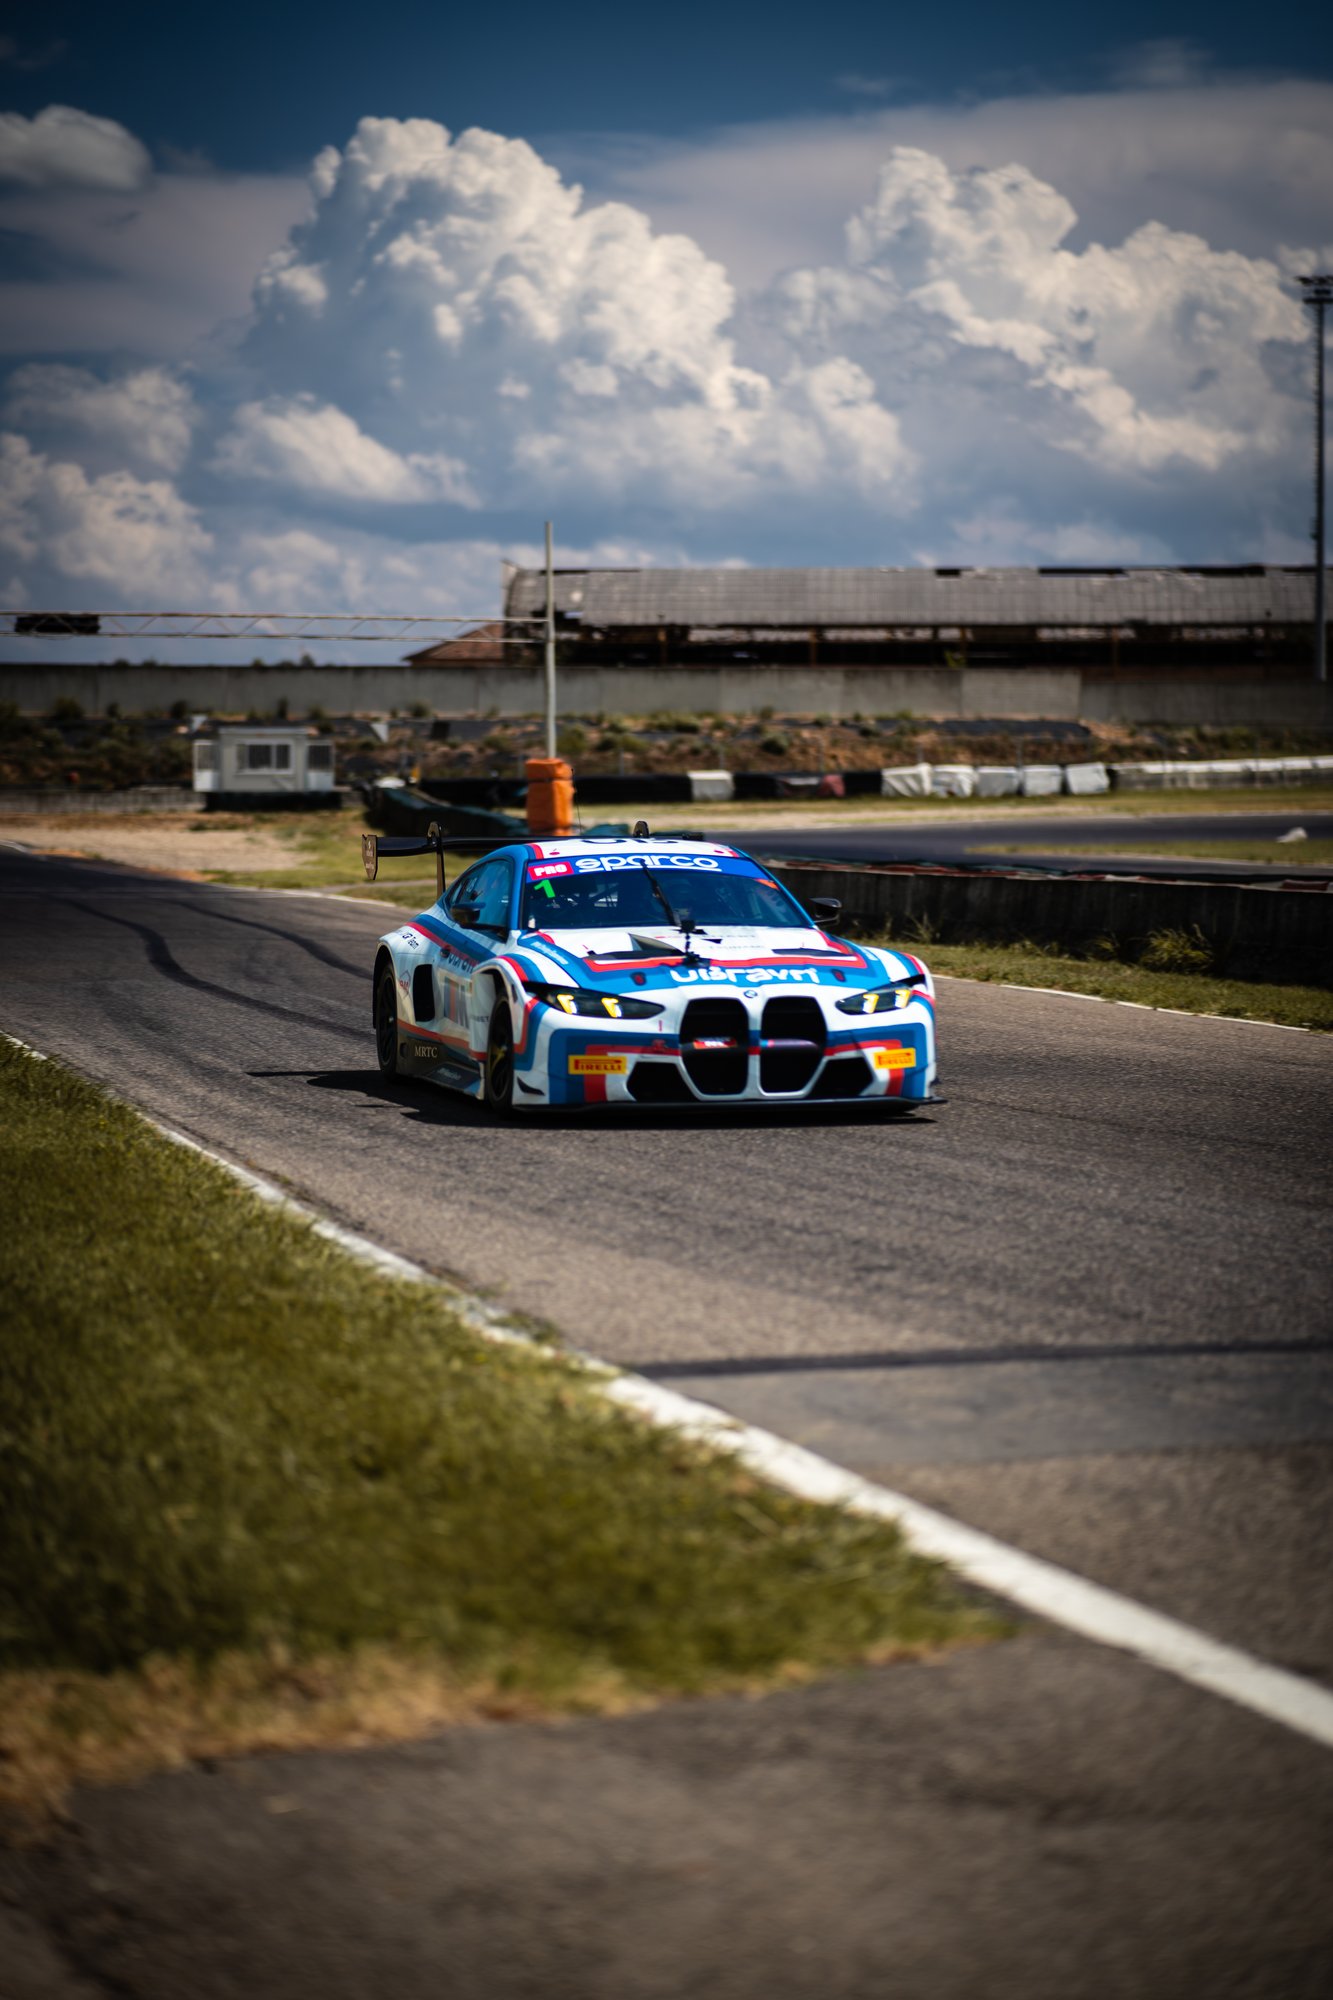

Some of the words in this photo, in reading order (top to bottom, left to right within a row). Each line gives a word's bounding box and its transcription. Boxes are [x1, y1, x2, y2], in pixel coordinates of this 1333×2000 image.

[575, 854, 721, 872] sparco
[533, 864, 568, 877] PRO
[533, 879, 555, 898] 1
[414, 1045, 438, 1058] MRTC
[574, 1059, 622, 1071] PIRELLI
